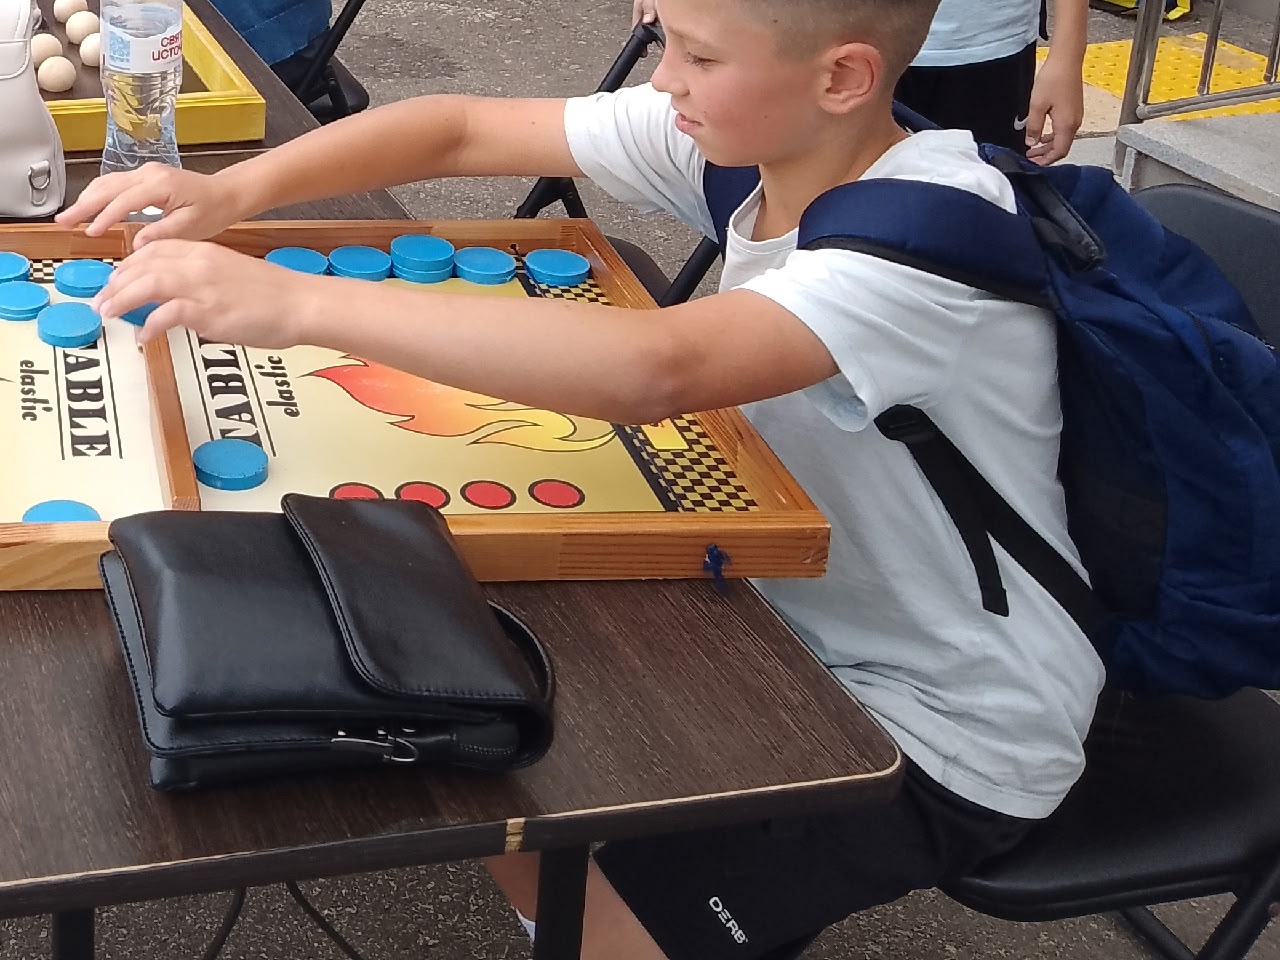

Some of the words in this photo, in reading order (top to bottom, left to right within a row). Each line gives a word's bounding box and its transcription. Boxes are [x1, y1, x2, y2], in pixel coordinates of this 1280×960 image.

[19, 359, 54, 422] elastic
[62, 340, 112, 458] ABLE
[253, 355, 301, 418] elastic
